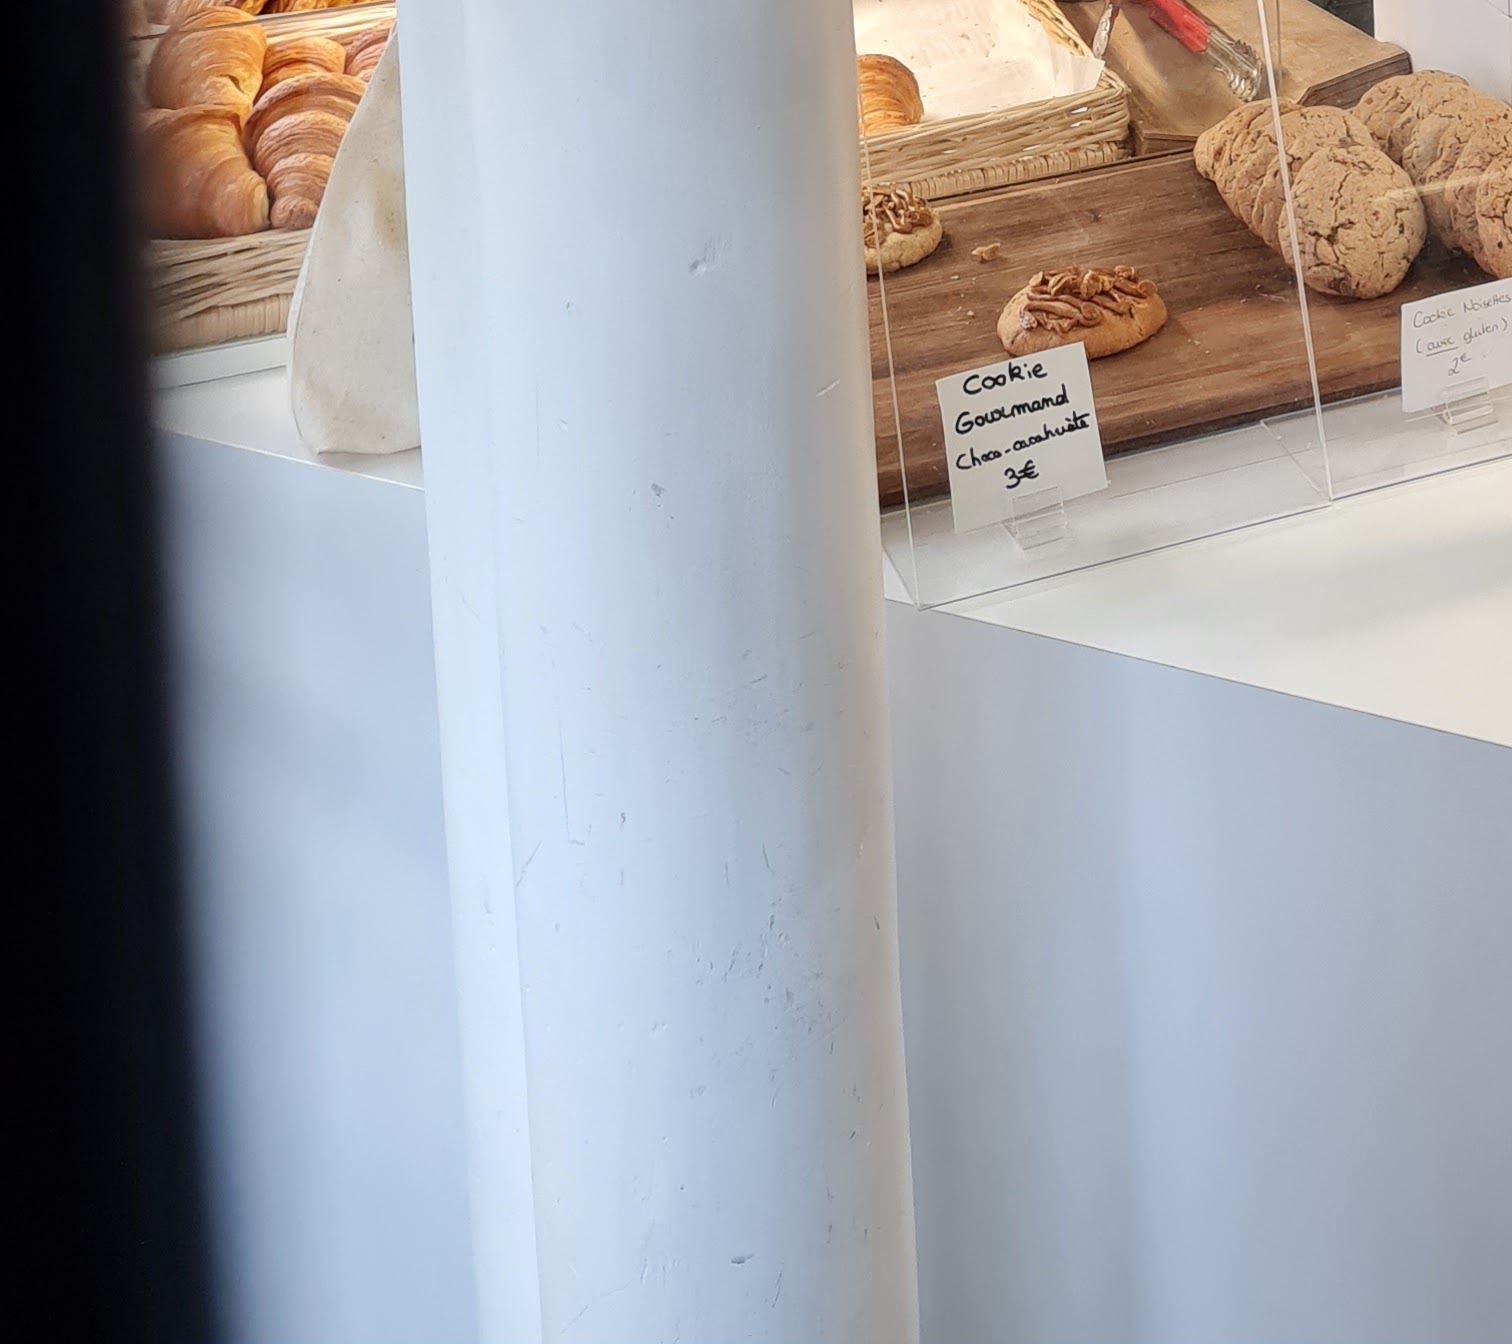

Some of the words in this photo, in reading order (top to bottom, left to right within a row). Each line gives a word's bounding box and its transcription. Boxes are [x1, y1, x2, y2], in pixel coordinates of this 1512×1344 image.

[1413, 308, 1455, 328] Cookie
[1463, 294, 1512, 313] Noisettes
[963, 362, 1048, 395] Cookie
[955, 384, 1069, 434] Gourmand
[1004, 460, 1039, 489] 3€
